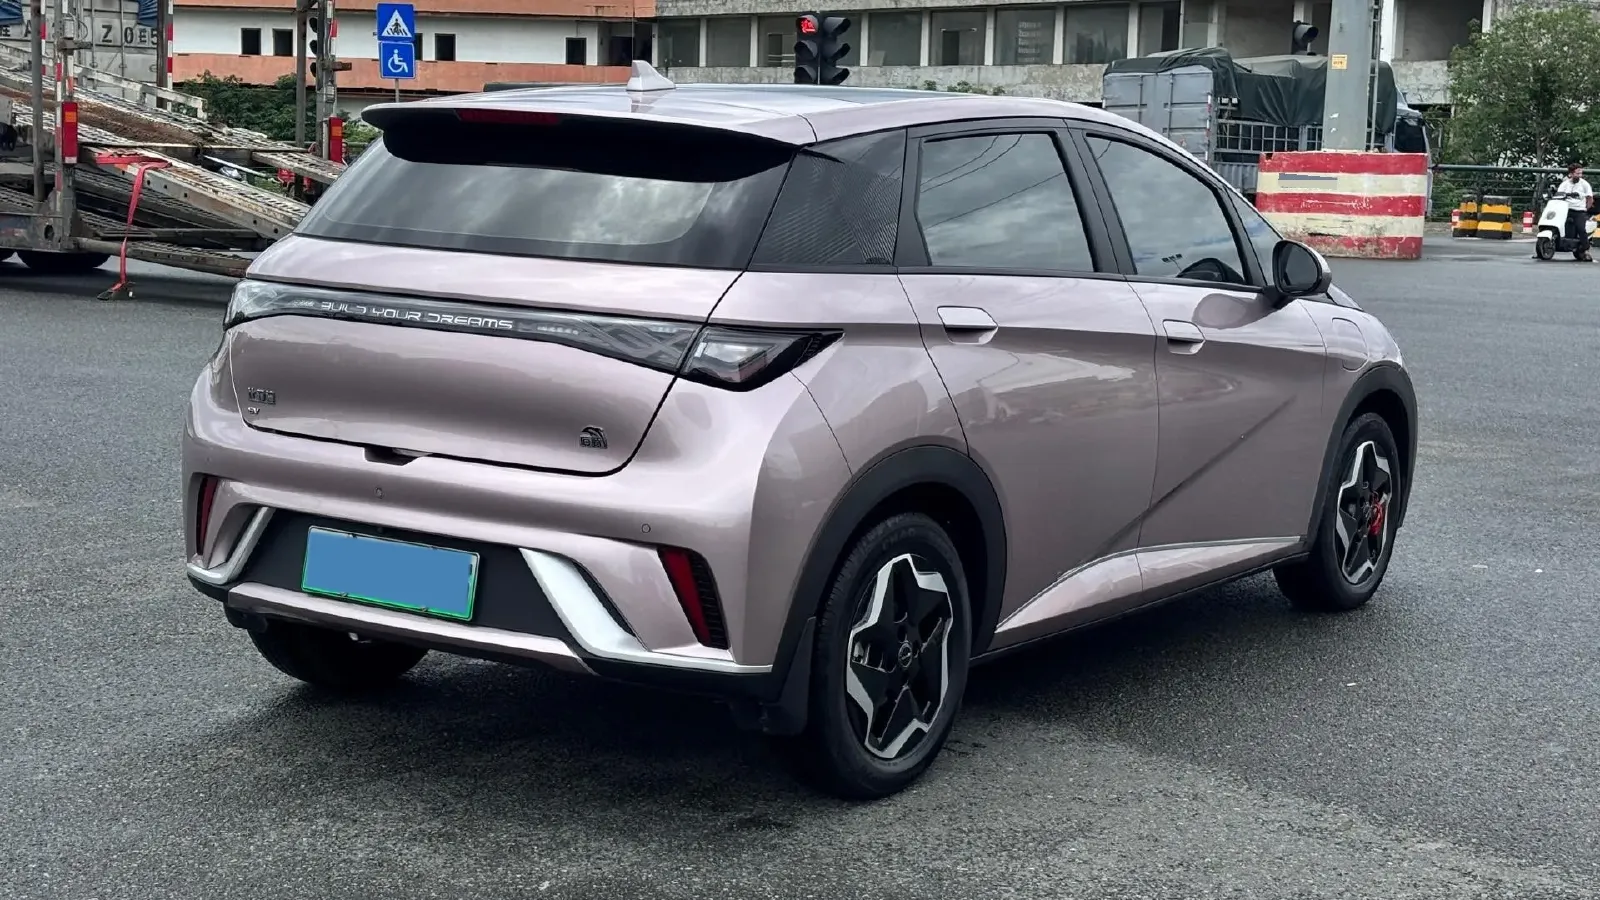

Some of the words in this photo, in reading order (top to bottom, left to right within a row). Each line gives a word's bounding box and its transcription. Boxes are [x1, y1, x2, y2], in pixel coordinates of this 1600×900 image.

[321, 301, 367, 313] BUILD
[373, 307, 421, 321] YOUR
[427, 313, 513, 329] DREAMS
